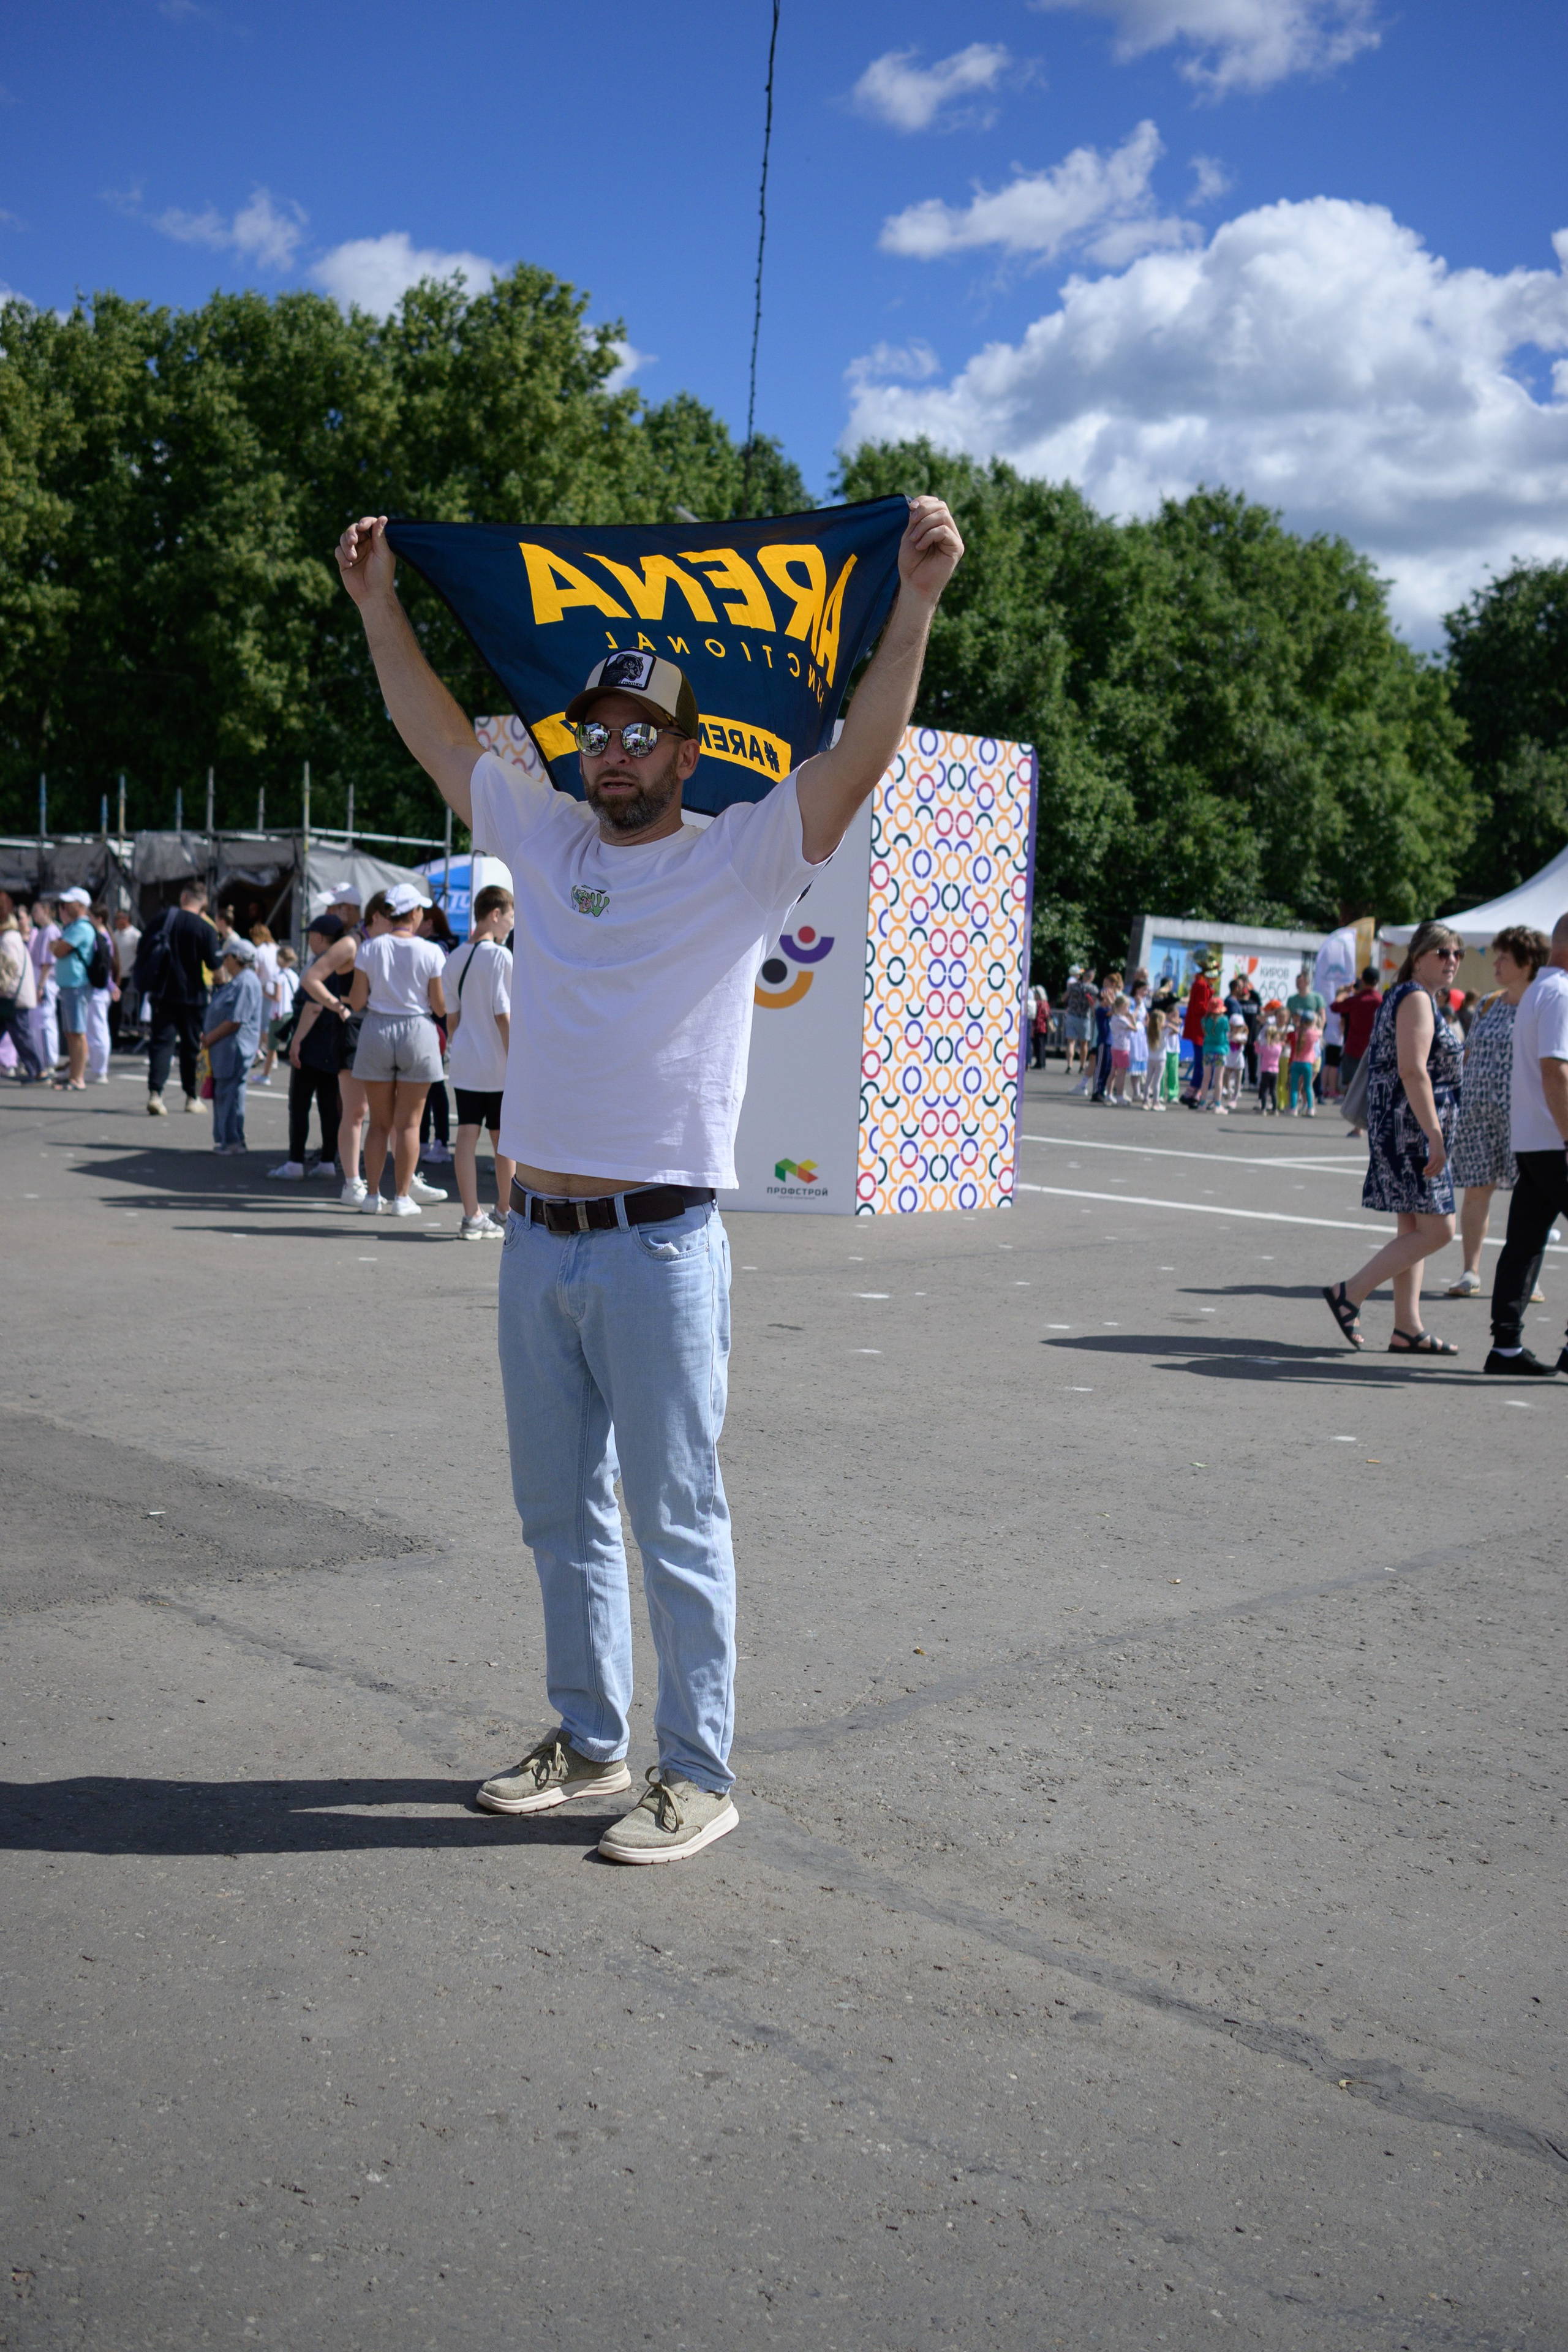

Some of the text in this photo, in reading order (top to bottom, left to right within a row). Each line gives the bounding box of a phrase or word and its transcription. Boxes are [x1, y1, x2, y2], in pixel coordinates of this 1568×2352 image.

[1260, 967, 1289, 978] КИРОВ
[1259, 980, 1287, 1001] 650
[767, 1186, 828, 1196] ПРОФСТРОЙ
